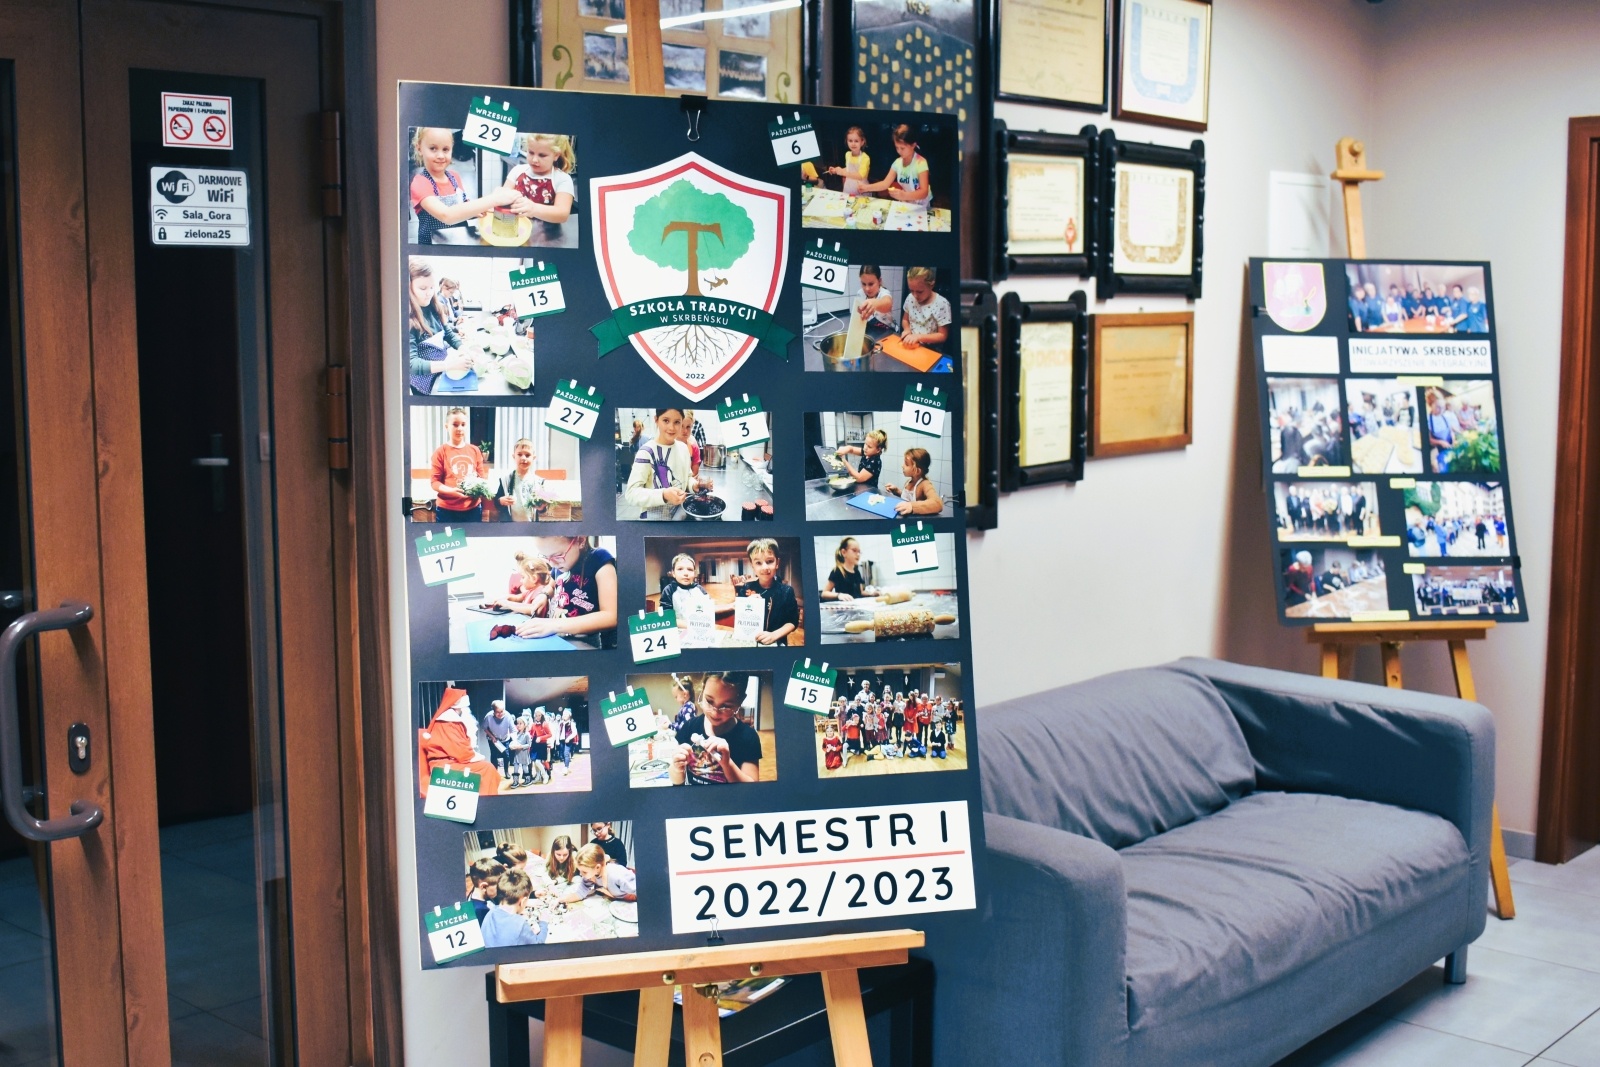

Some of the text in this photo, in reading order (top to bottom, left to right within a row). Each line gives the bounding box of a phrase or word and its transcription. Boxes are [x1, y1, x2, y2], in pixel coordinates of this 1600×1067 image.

[475, 107, 513, 123] WRZESIEŃ
[478, 124, 502, 142] 29
[791, 140, 801, 155] 6
[198, 174, 242, 187] DARMOWE
[207, 188, 235, 203] WiFi
[182, 209, 232, 221] Sala_Gora
[184, 227, 231, 239] zielona25
[813, 265, 835, 283] 20
[528, 290, 548, 307] 13
[629, 300, 757, 321] SZKOŁA TRADYCJI
[660, 313, 729, 326] W SKRBEŃSKU
[1352, 345, 1419, 356] INICJATYWA
[910, 395, 942, 407] LISTOPAD
[559, 407, 585, 426] 27
[724, 406, 757, 419] LISTOPAD
[914, 409, 932, 426] 10
[738, 421, 750, 437] 3
[423, 540, 461, 554] LISTOPAD
[896, 533, 930, 545] GRUDZIEŃ
[435, 555, 455, 573] 17
[911, 549, 919, 564] 1
[635, 620, 671, 632] LISTOPAD
[643, 635, 668, 653] 24
[796, 671, 831, 685] GRUDZIEŃ
[800, 687, 819, 704] 15
[607, 697, 644, 715] GRUDZIEŃ
[625, 717, 637, 732] 8
[435, 777, 475, 790] GRUDZIEŃ
[446, 795, 457, 811] 6
[689, 810, 948, 862] SEMESTR I
[693, 866, 954, 921] 2022/2023
[434, 912, 469, 929] STYCZEŃ
[445, 930, 468, 949] 12
